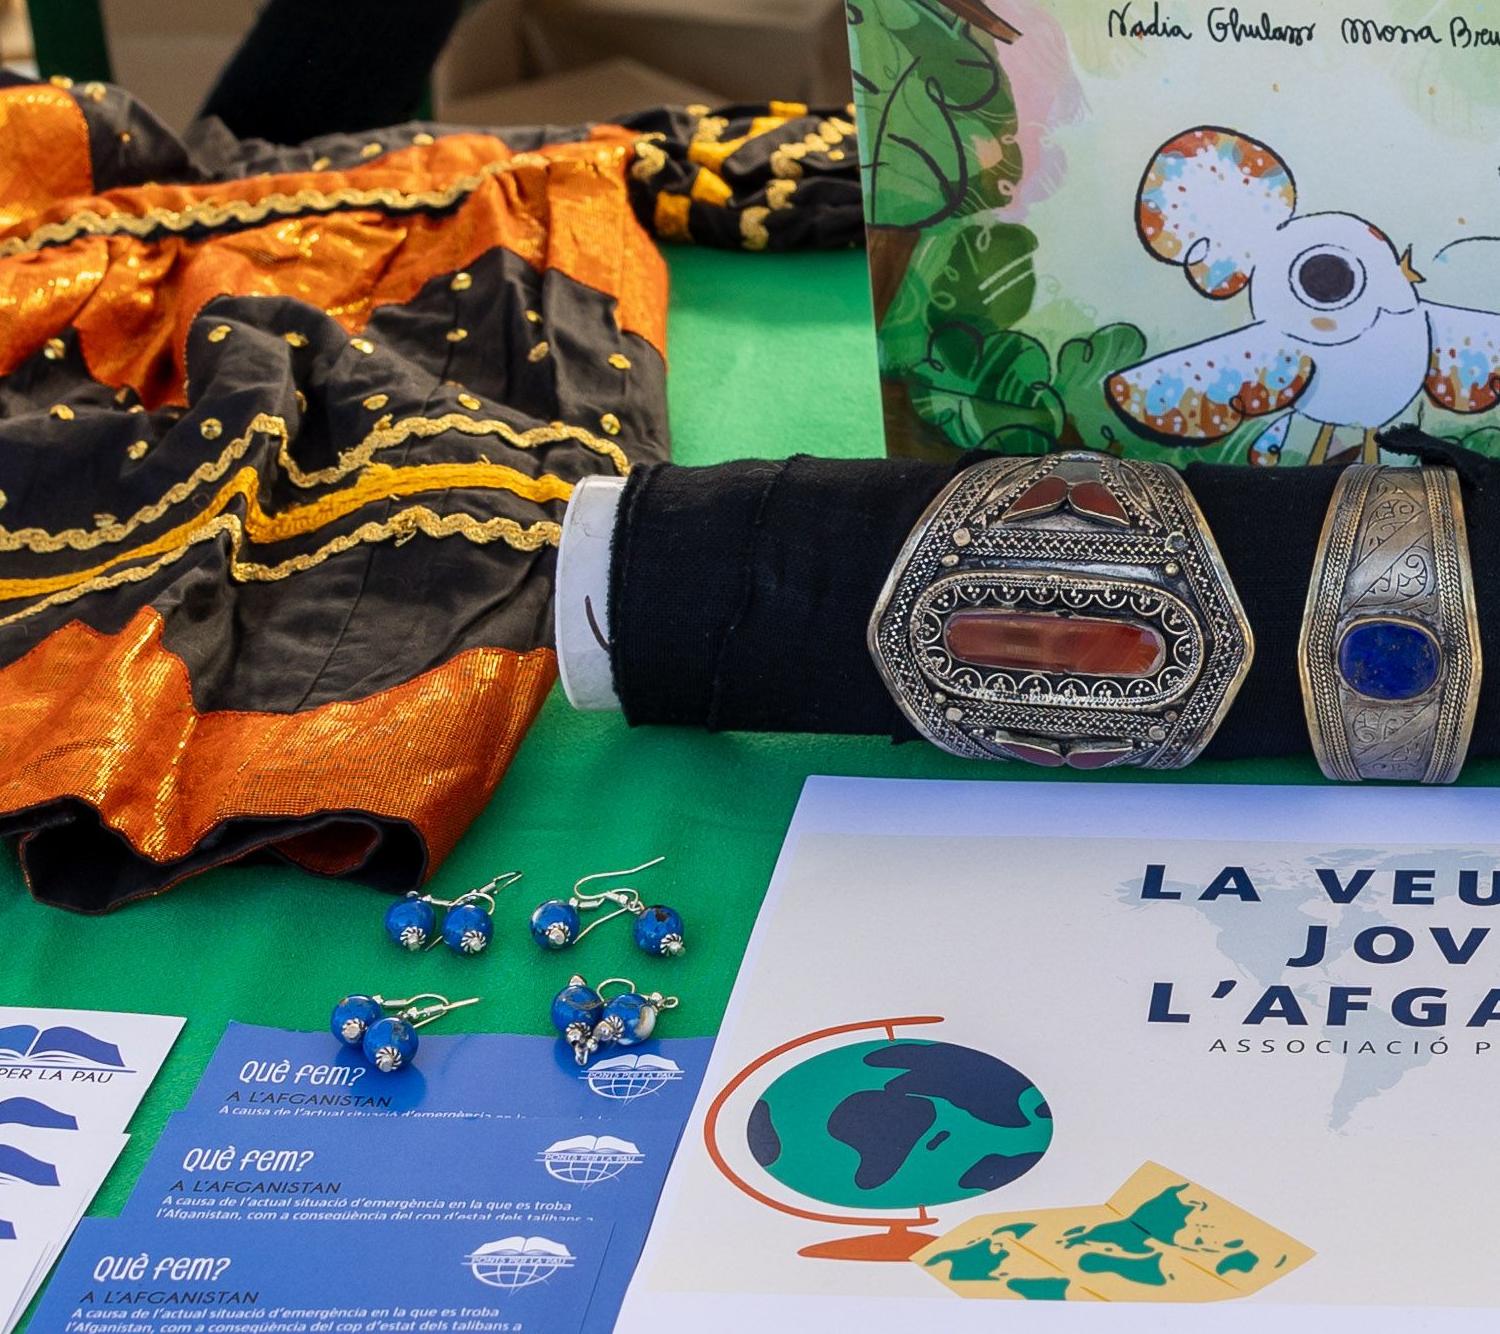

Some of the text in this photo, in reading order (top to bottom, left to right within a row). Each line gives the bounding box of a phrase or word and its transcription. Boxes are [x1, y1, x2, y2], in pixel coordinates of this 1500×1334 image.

[1109, 2, 1192, 40] Nadia
[1207, 7, 1316, 46] Ghulam
[1342, 15, 1439, 46] Mona
[1140, 864, 1261, 902] LA
[1208, 1036, 1448, 1054] ASSOCIACIÓ
[38, 1070, 62, 1080] LA
[71, 1071, 113, 1083] PAU
[226, 1090, 392, 1107] A L'AFGANISTAN
[182, 1145, 314, 1172] Què fem?
[168, 1180, 341, 1194] A L'AFGANISTAN
[161, 1195, 173, 1206] A
[174, 1197, 217, 1207] causa
[217, 1196, 238, 1207] de
[292, 1197, 348, 1208] situació
[447, 1201, 467, 1209] en
[468, 1199, 483, 1210] la
[484, 1201, 513, 1212] que
[514, 1202, 531, 1211] es
[533, 1200, 573, 1212] troba
[93, 1252, 230, 1282] Què fem?
[79, 1290, 259, 1304] A L'AFGANISTAN
[70, 1308, 83, 1319] A
[84, 1310, 129, 1320] causa
[129, 1308, 151, 1320] de
[208, 1308, 266, 1320] situació
[369, 1309, 390, 1318] en
[391, 1306, 407, 1318] la
[408, 1308, 439, 1320] que
[439, 1308, 457, 1318] es
[459, 1307, 500, 1318] troba
